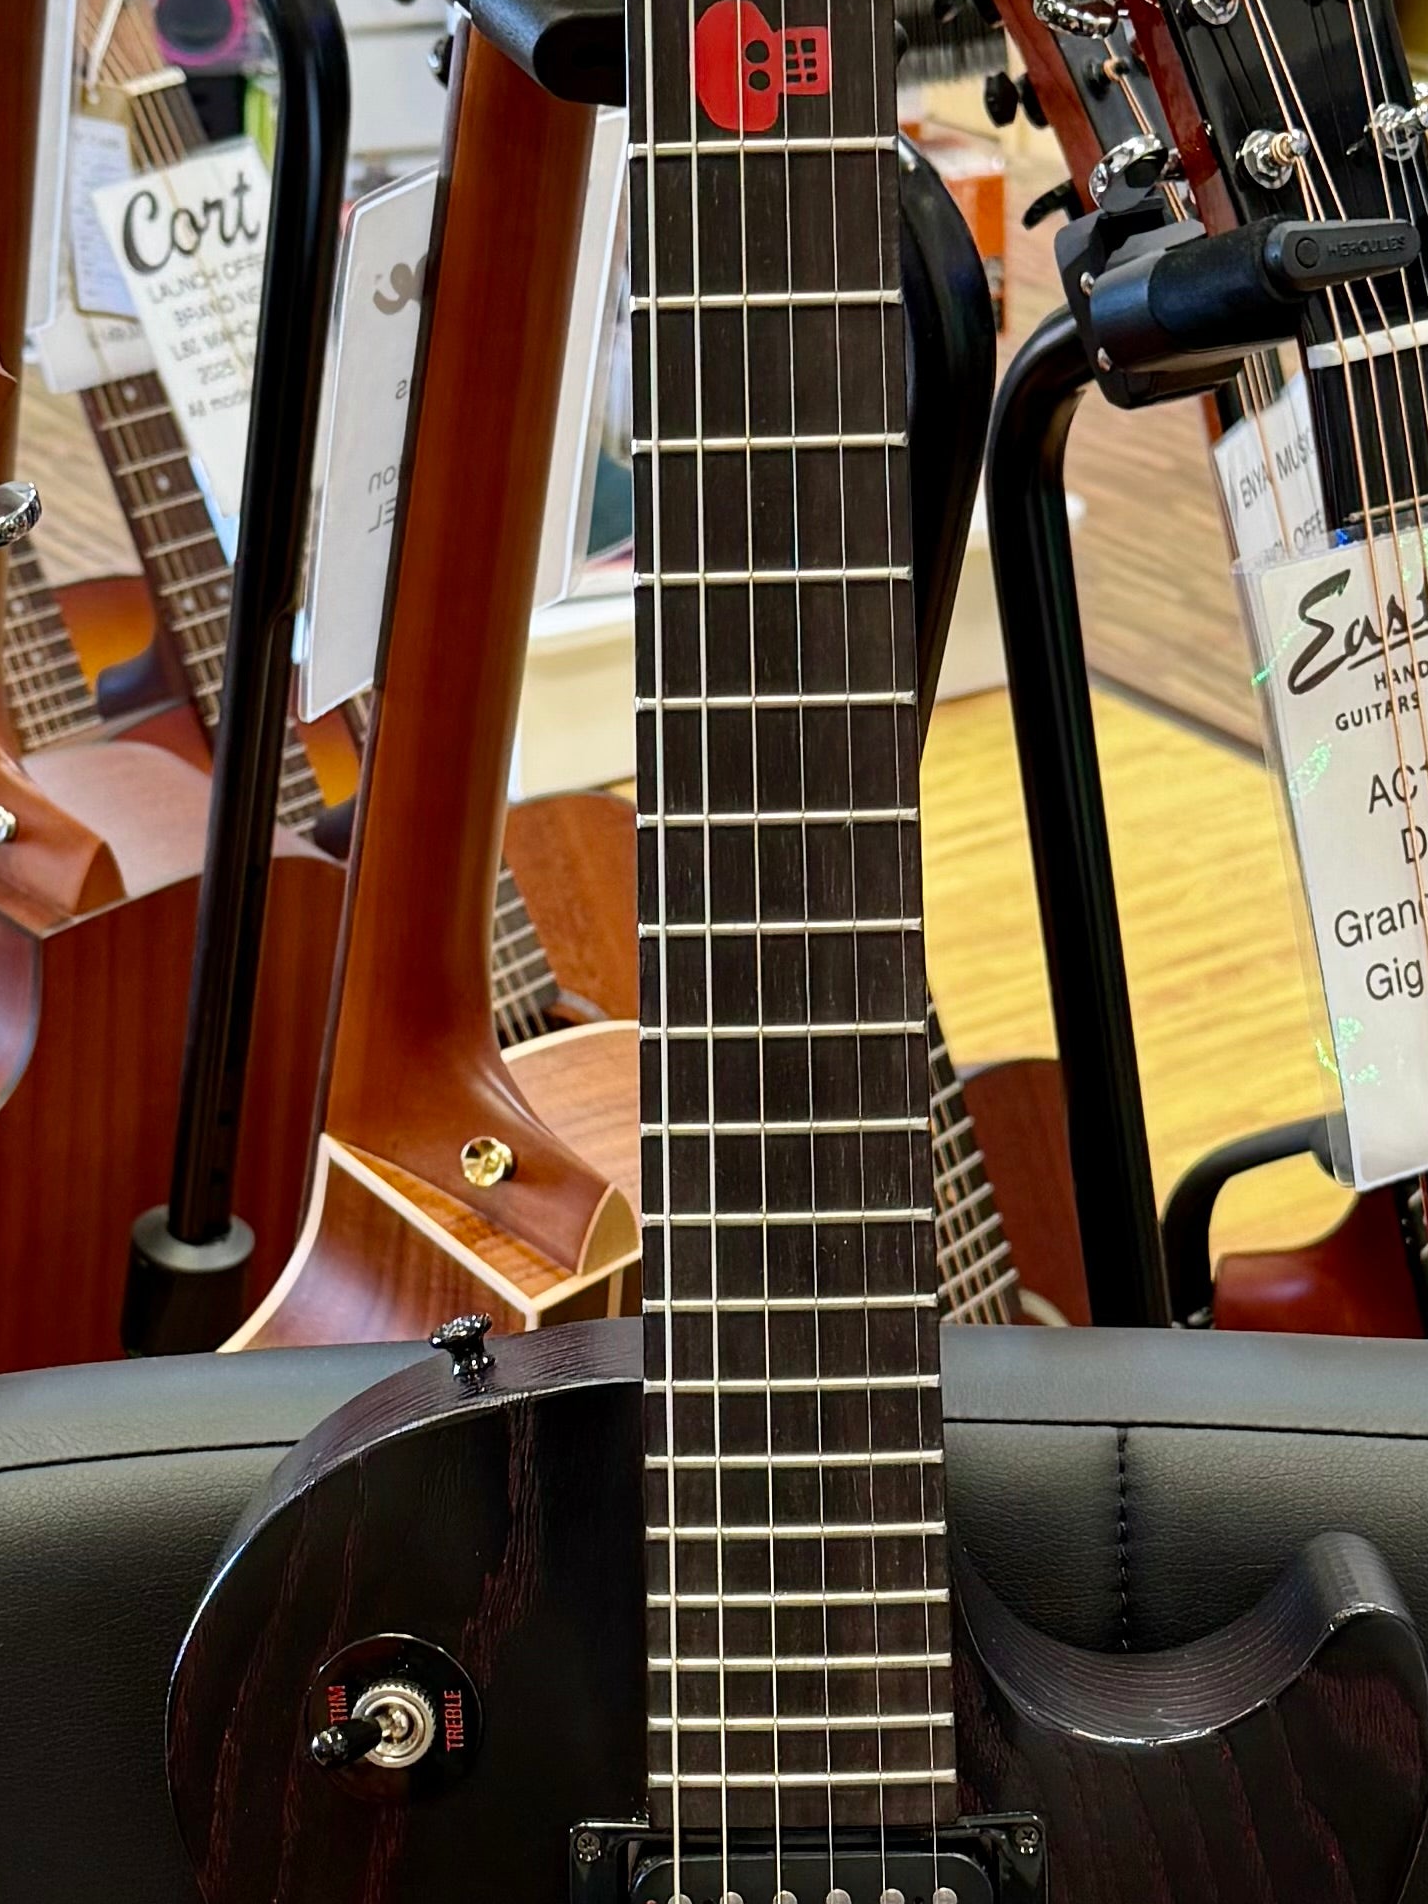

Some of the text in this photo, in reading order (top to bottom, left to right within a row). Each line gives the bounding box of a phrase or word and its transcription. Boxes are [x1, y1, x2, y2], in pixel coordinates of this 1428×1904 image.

[121, 171, 261, 277] Cort
[223, 253, 265, 281] OFFE
[1327, 236, 1405, 258] HERCULES
[1335, 688, 1421, 732] GUITARS
[1365, 958, 1425, 1000] Gig
[443, 1689, 465, 1753] TREBLE
